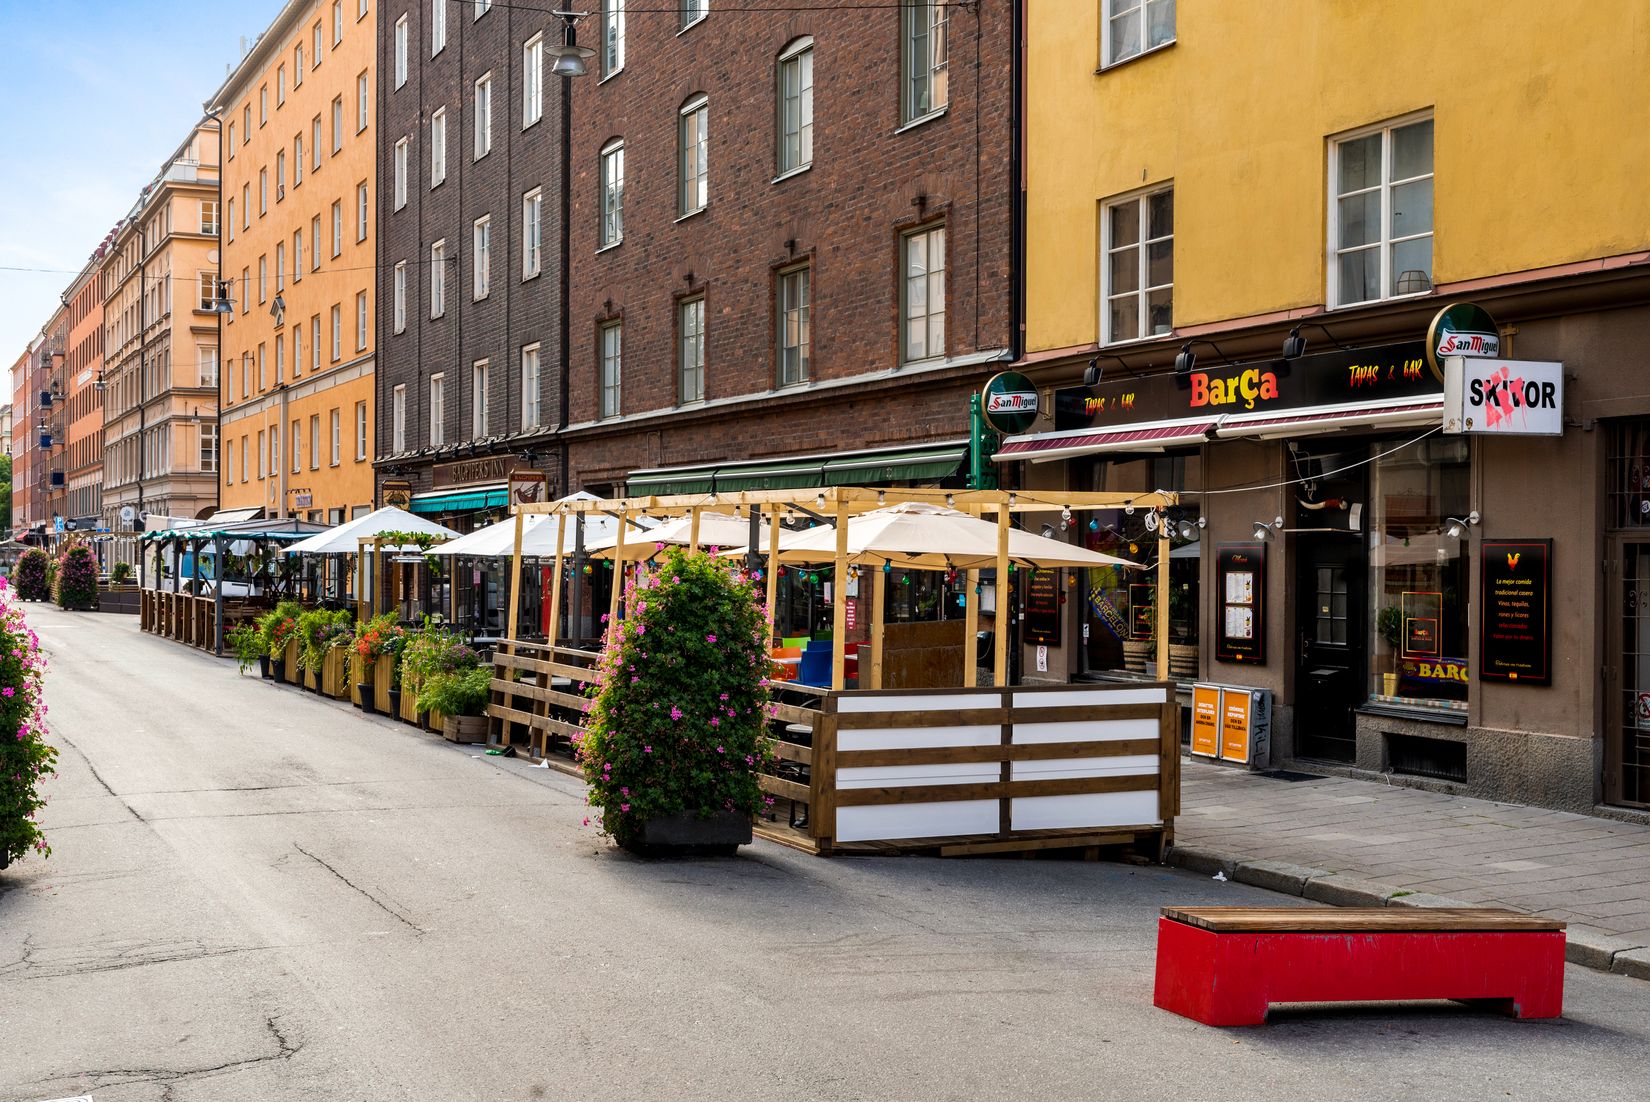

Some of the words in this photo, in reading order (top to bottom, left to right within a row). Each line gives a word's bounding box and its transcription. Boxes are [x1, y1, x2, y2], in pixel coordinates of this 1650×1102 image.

[1348, 364, 1379, 387] TAPAS
[1387, 365, 1396, 380] &
[452, 460, 489, 482] BAGPIPERS
[491, 458, 505, 479] INN
